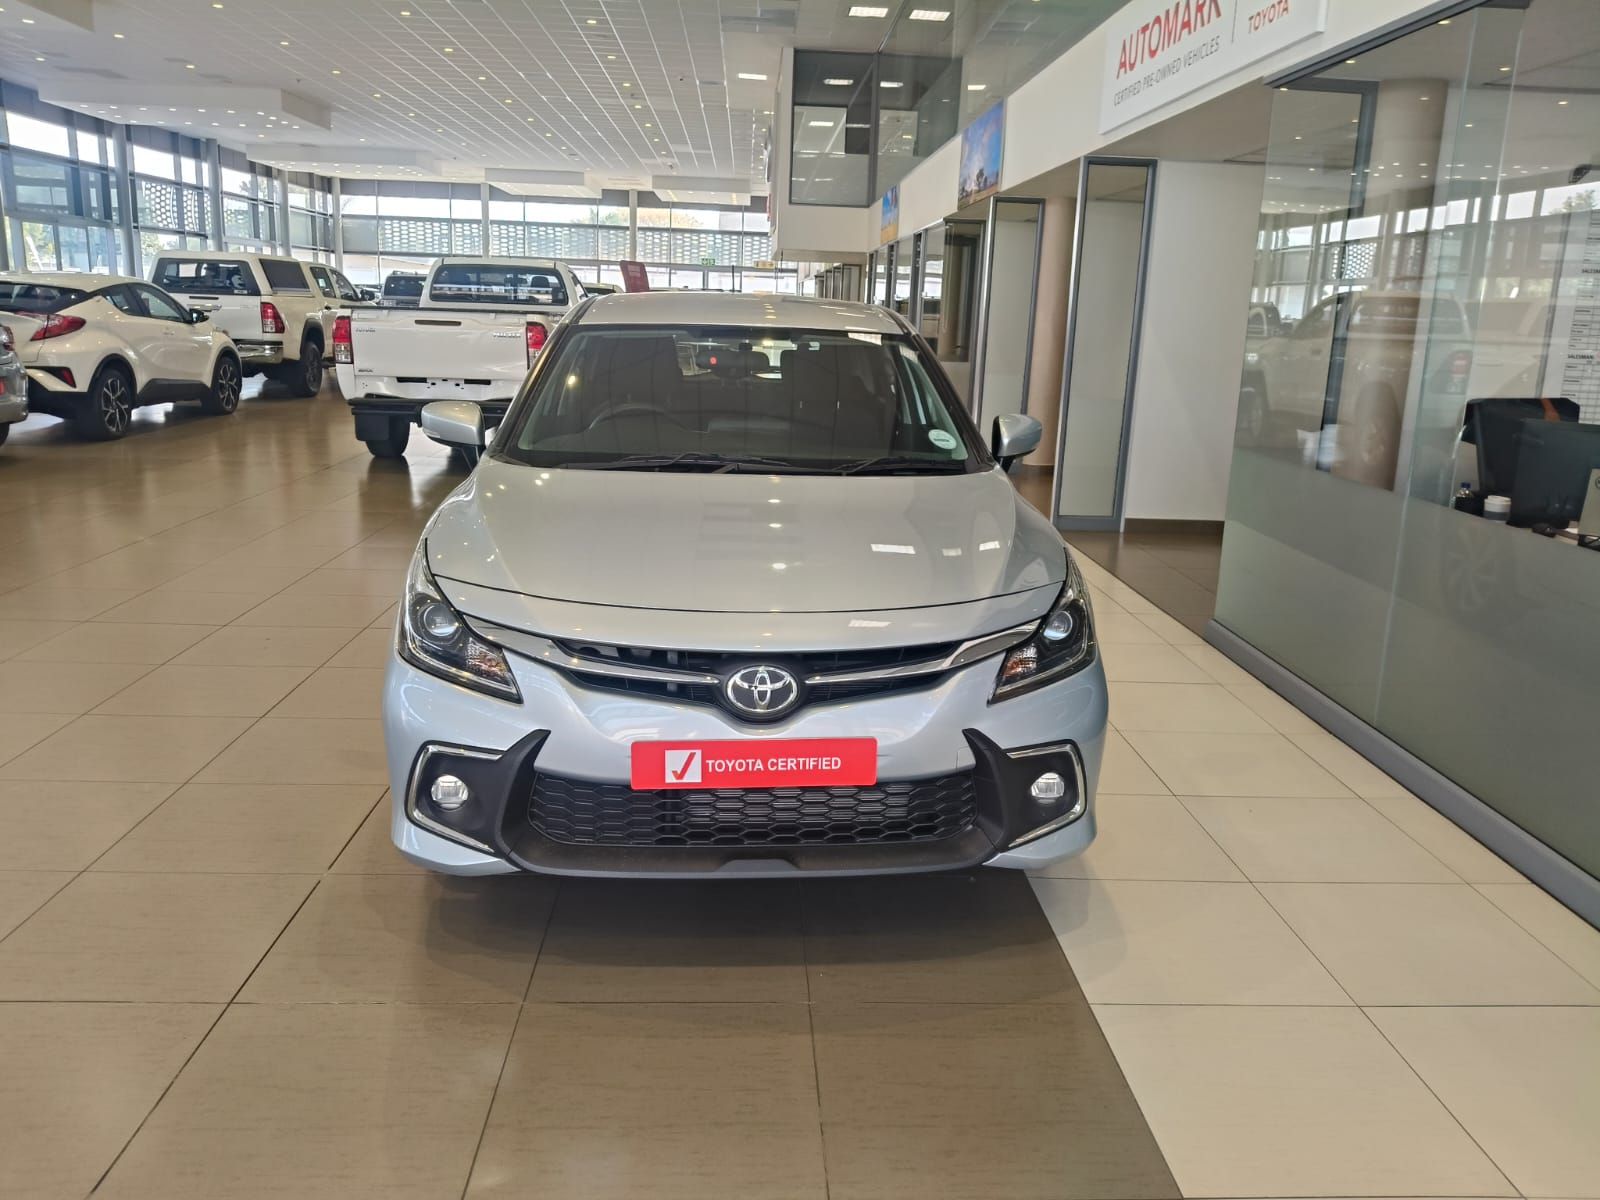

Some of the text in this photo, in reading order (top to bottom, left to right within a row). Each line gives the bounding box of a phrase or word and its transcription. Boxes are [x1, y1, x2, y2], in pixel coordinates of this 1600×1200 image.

[1116, 0, 1222, 79] AUTOMARK
[1248, 0, 1289, 34] TOYOTA
[1113, 35, 1220, 106] CERTIFIED PRE-OWNED VEHICLES
[706, 756, 842, 773] TOYOTA CERTIFIED
